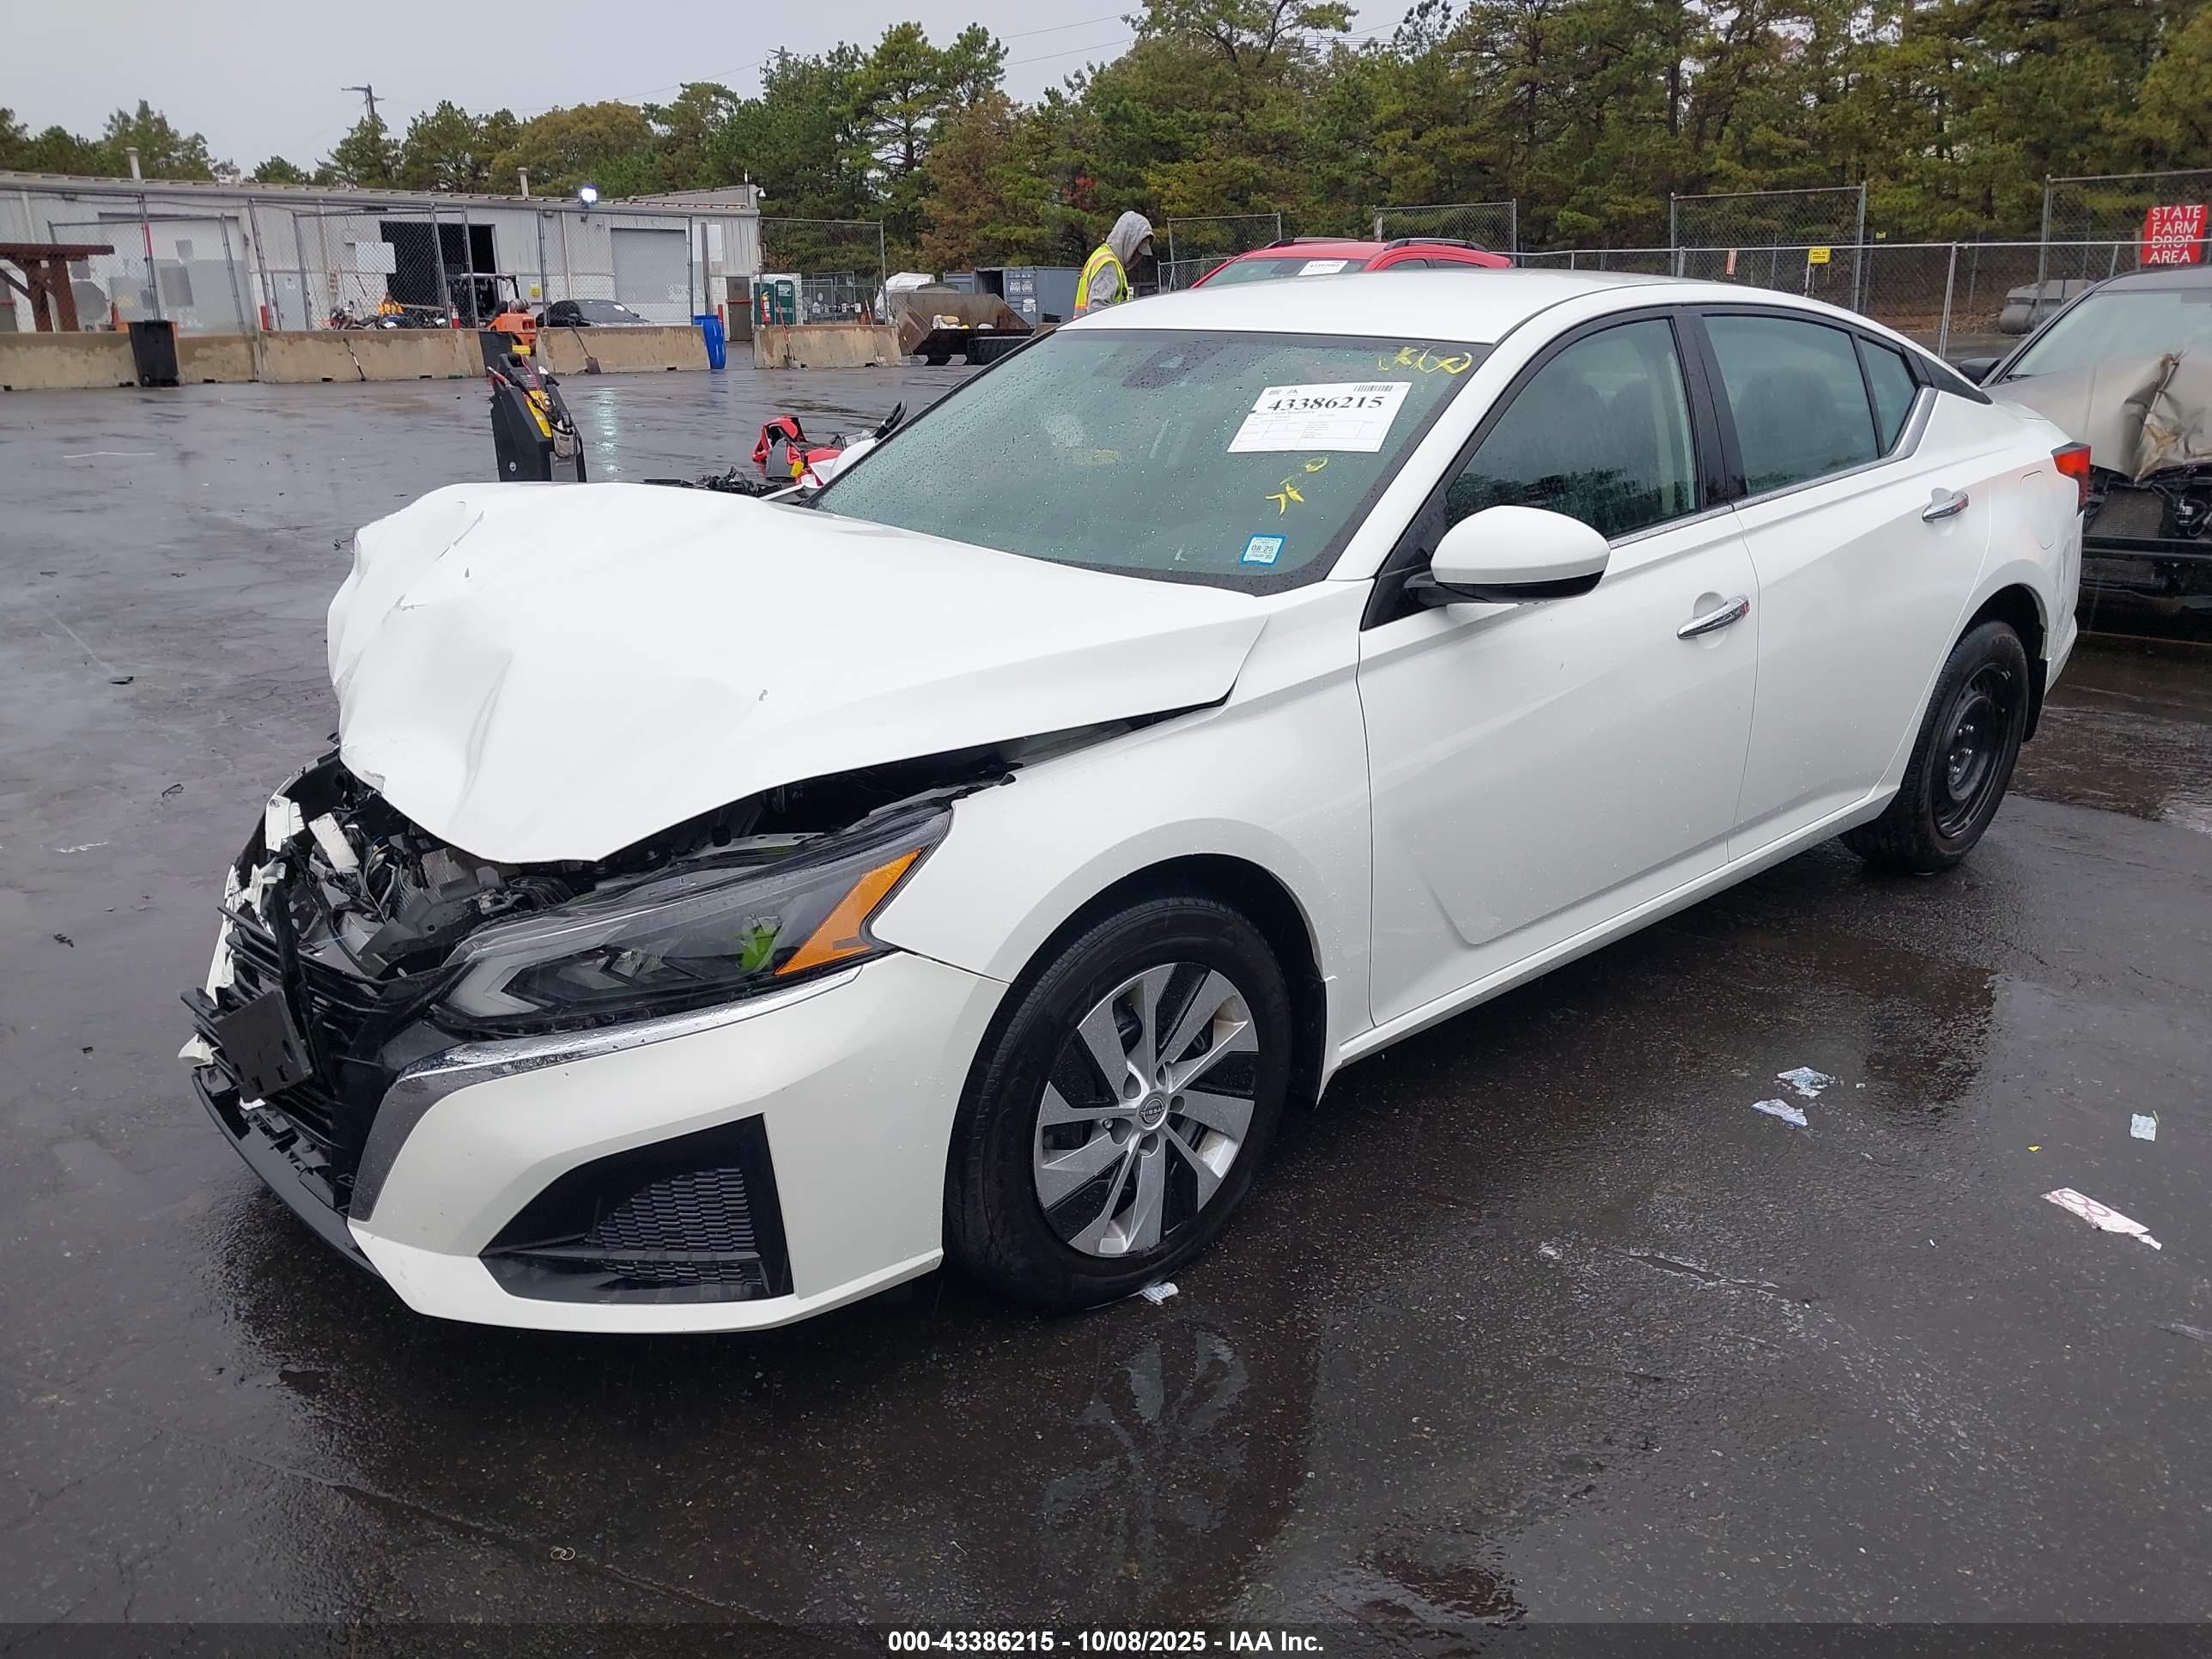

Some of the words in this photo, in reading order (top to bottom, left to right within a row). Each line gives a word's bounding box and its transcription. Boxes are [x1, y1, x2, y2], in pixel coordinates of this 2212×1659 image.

[2151, 205, 2203, 220] STATE
[2152, 220, 2197, 235] FARM
[2151, 234, 2194, 249] DROP
[2148, 250, 2191, 264] AREA
[1267, 396, 1385, 411] 43386215
[1139, 1105, 1164, 1116] NISSAN
